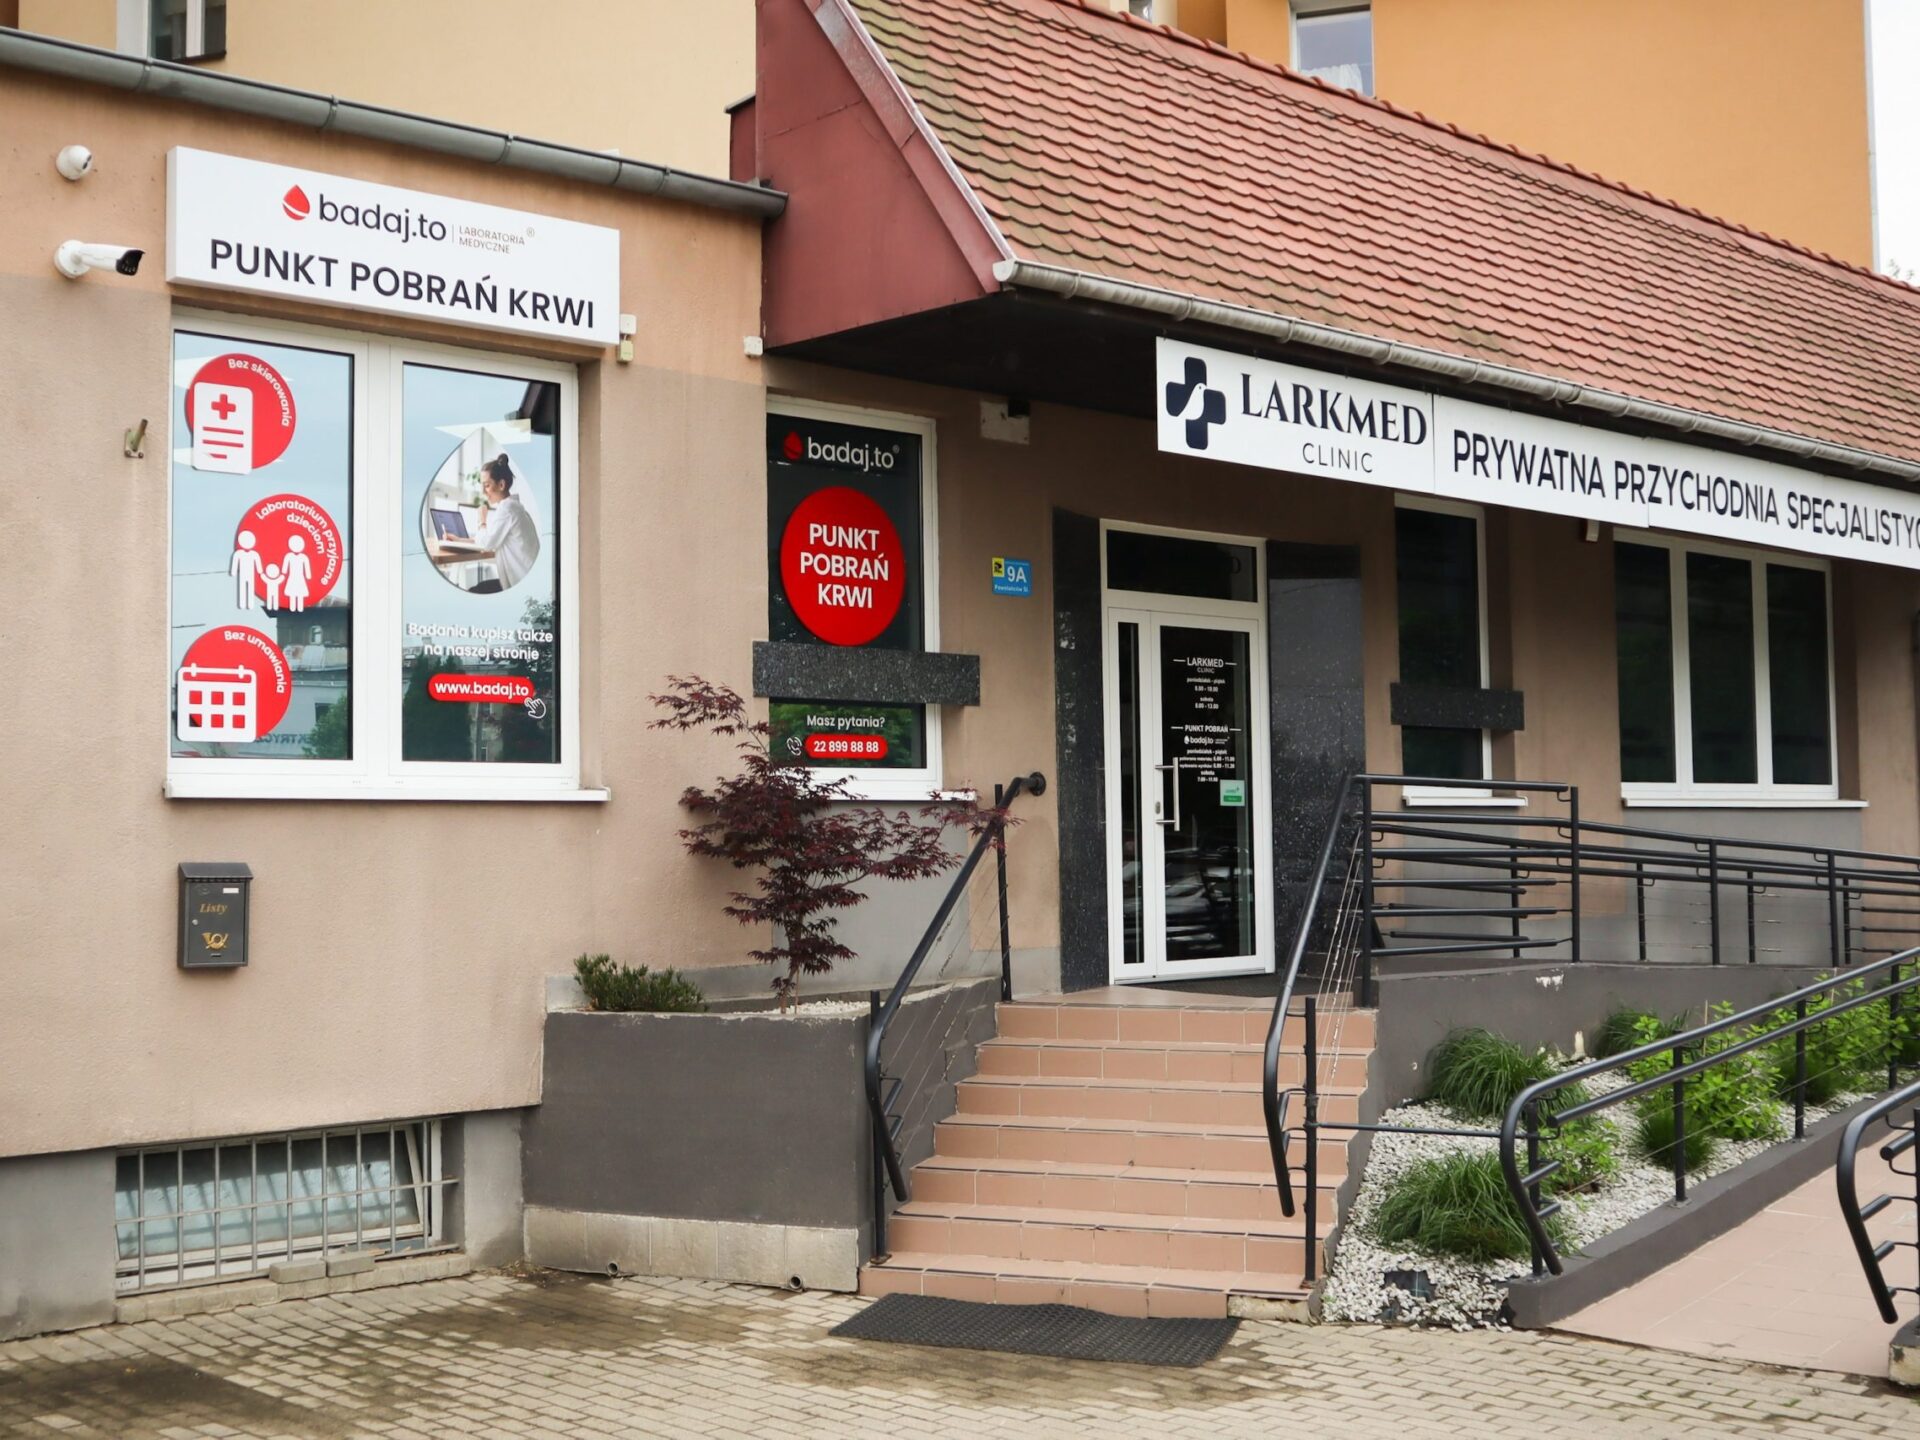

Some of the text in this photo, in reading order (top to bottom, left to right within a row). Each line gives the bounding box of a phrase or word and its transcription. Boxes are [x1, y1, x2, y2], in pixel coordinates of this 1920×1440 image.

[319, 193, 447, 244] badaj.to
[459, 225, 526, 246] LABORATORIA
[459, 236, 511, 254] MEDYCZNE
[210, 238, 594, 329] PUNKT POBRAŃ KRWI
[227, 358, 293, 427] Bez skierowania
[1240, 373, 1428, 446] LARKMED
[807, 436, 895, 472] badaj.to
[1302, 442, 1374, 474] CLINIC
[1453, 429, 1606, 498] PRYWATNA
[1614, 460, 1780, 526] PRZYCHODNIA
[255, 500, 339, 586] Laboratorium przyjazne
[286, 512, 325, 555] dzieciom
[809, 523, 880, 551] PUNKT
[800, 552, 889, 581] POBRAŃ
[1007, 565, 1028, 583] 9A
[818, 583, 873, 608] KRWI
[407, 622, 554, 643] Badania kupisz także
[223, 630, 288, 694] Bez umawiania
[424, 645, 540, 661] na naszej stronie
[1187, 657, 1224, 668] LARKMED
[435, 681, 529, 699] www.badaj.to
[806, 715, 886, 730] Masz pytania?
[1185, 724, 1204, 732] PUNKT
[813, 740, 879, 753] 22 899 88 88
[199, 903, 228, 915] Listy
